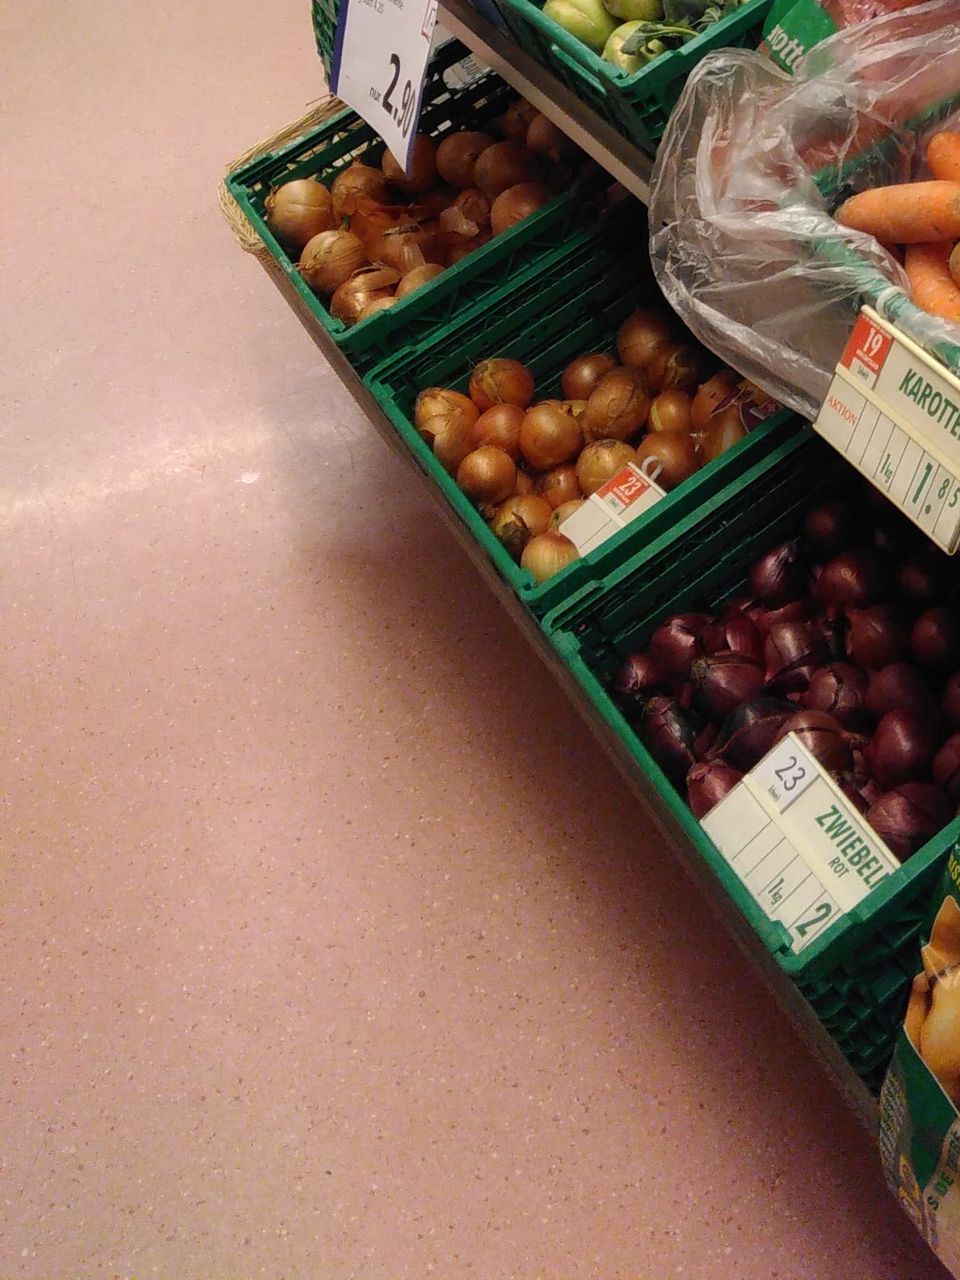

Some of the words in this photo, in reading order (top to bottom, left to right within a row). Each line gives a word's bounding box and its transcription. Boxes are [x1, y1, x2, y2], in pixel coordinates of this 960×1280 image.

[369, 86, 382, 104] nur
[381, 53, 418, 140] 2.90
[862, 327, 883, 358] 19
[827, 395, 859, 428] AKTION
[618, 476, 642, 497] 23
[775, 755, 807, 792] 23
[827, 857, 850, 879] ROT
[767, 877, 786, 907] 1kg
